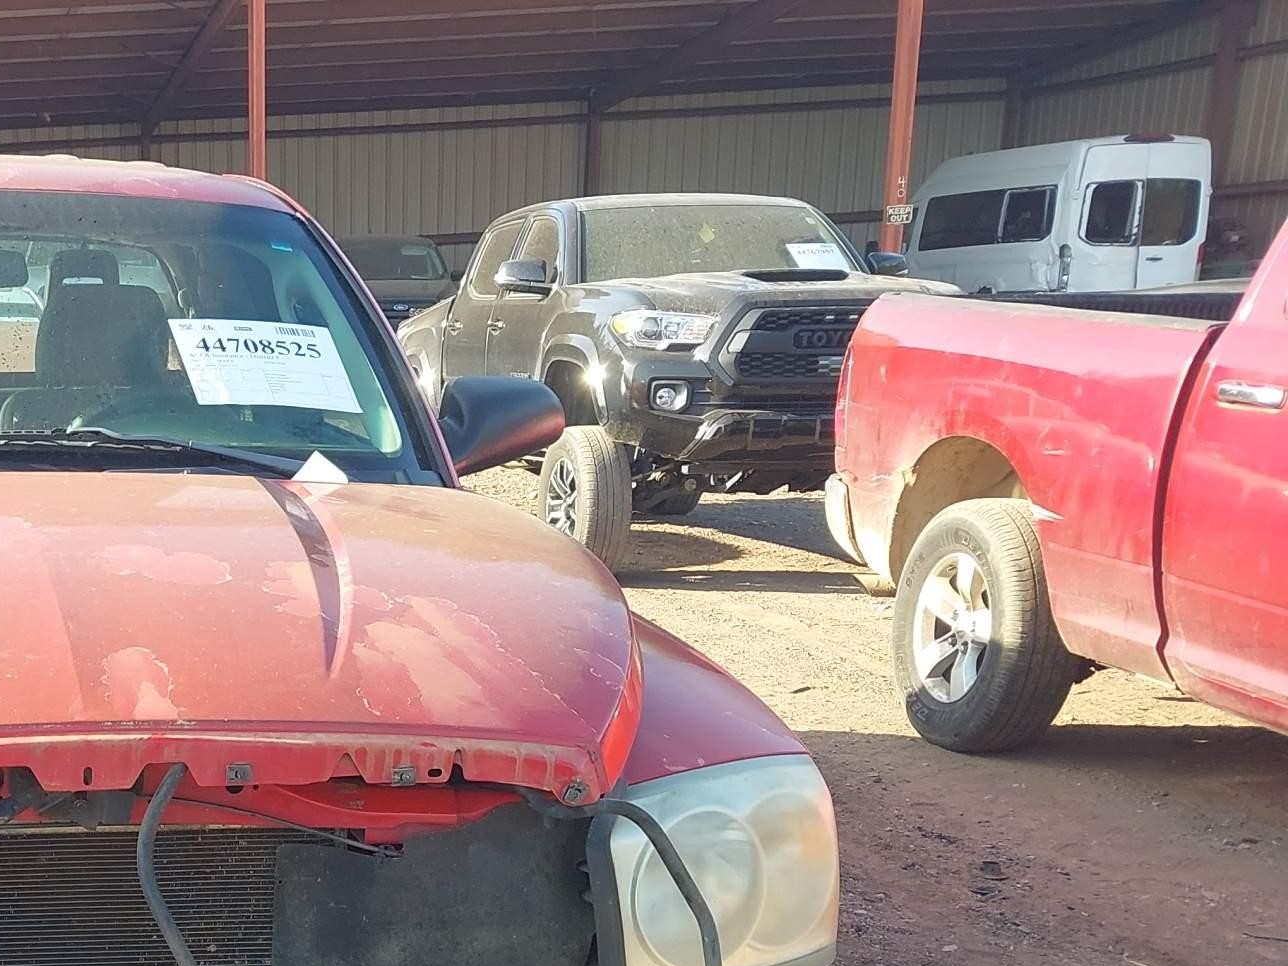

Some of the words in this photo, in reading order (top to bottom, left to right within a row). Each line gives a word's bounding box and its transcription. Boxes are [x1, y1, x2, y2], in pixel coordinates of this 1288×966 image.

[888, 206, 911, 215] KEEP
[890, 214, 908, 222] OUT
[196, 337, 322, 359] 44708525
